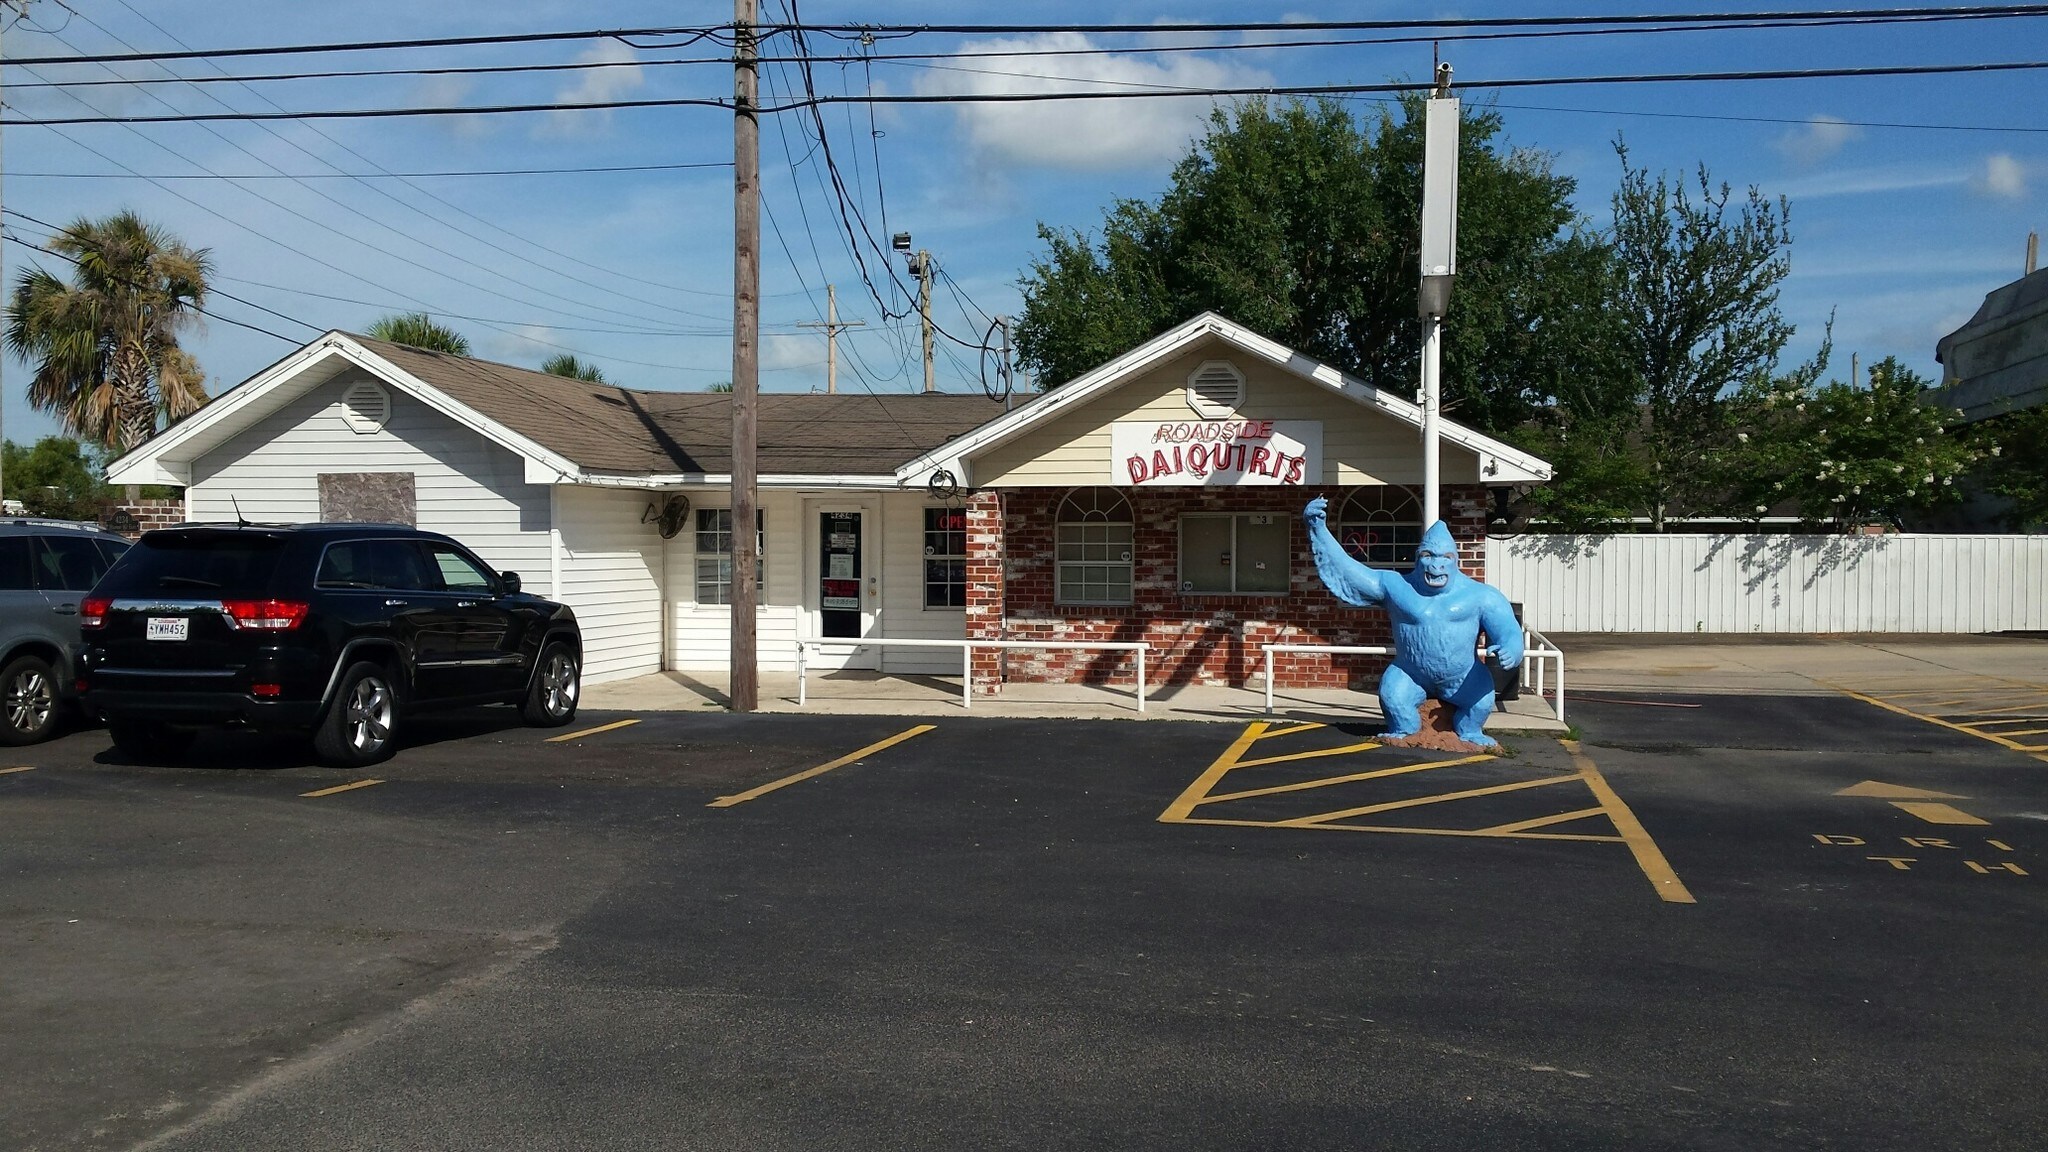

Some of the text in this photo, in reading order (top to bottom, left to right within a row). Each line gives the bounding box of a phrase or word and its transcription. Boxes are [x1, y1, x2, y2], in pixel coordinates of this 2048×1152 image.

[1156, 421, 1275, 441] ROADSIDE
[1127, 443, 1306, 484] DAIQUIRIS
[940, 515, 966, 529] OPE
